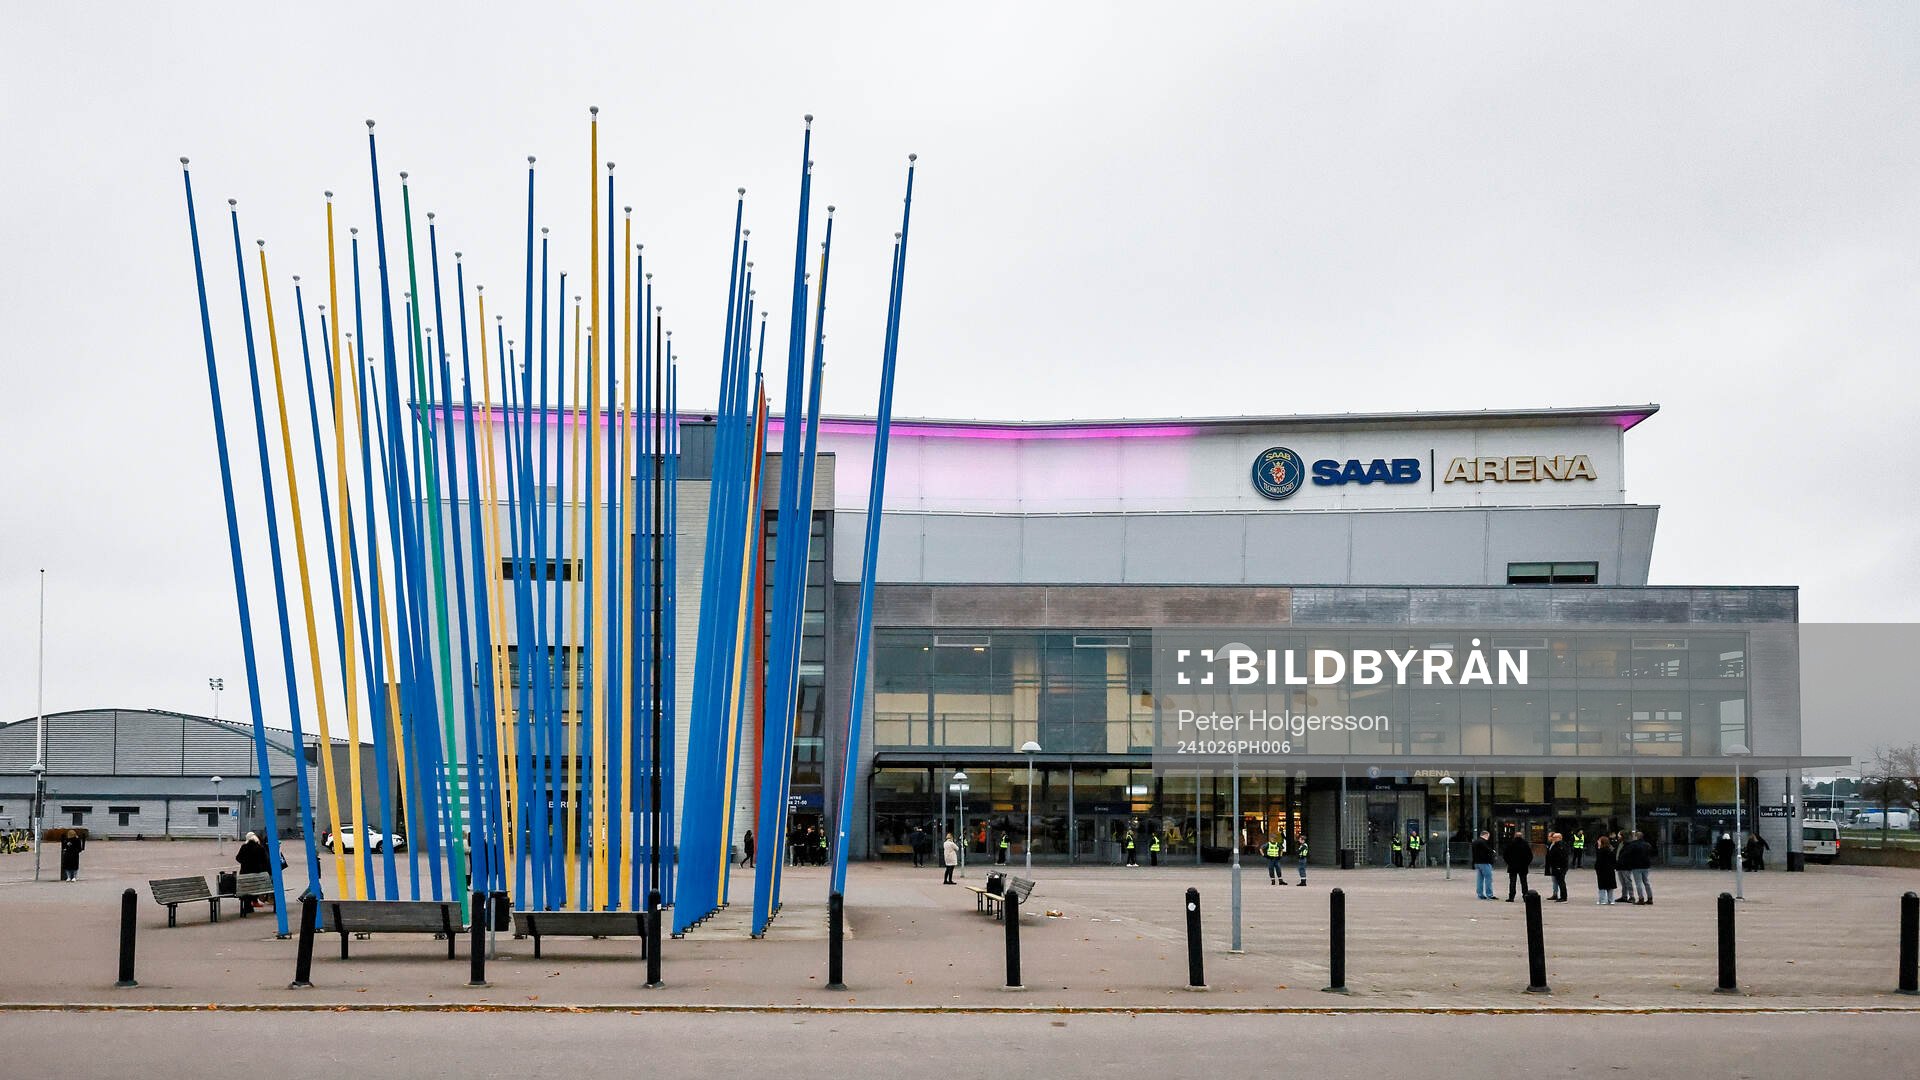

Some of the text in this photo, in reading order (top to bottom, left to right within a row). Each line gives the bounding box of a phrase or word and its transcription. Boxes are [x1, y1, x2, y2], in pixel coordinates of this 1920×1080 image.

[1265, 451, 1291, 461] SAAB
[1311, 453, 1598, 487] SAAB ARENA
[1414, 769, 1451, 777] ARENA
